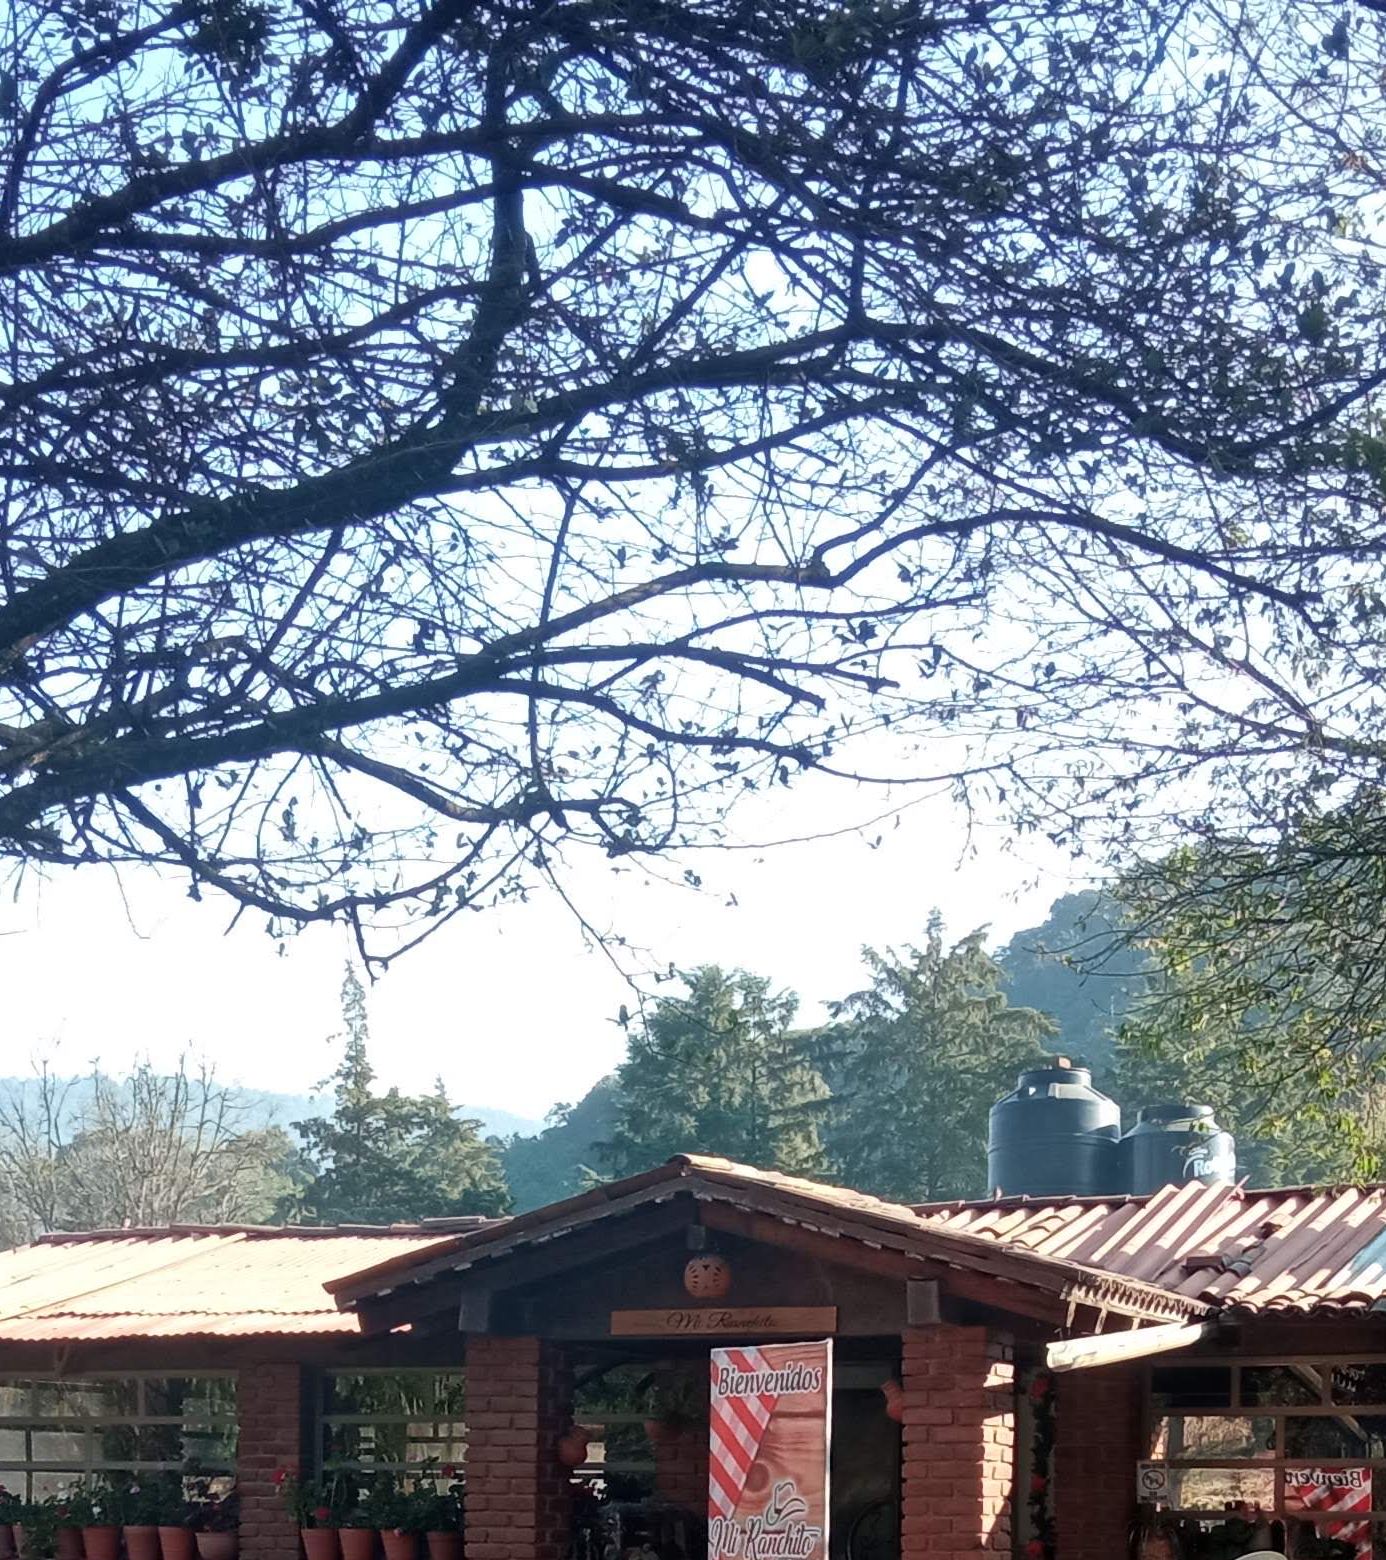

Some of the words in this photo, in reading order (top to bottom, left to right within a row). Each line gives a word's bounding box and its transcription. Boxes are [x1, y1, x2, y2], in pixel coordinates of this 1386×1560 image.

[667, 1312, 700, 1330] Mi
[718, 1362, 821, 1396] Bienvenidos
[708, 1517, 740, 1557] Mi
